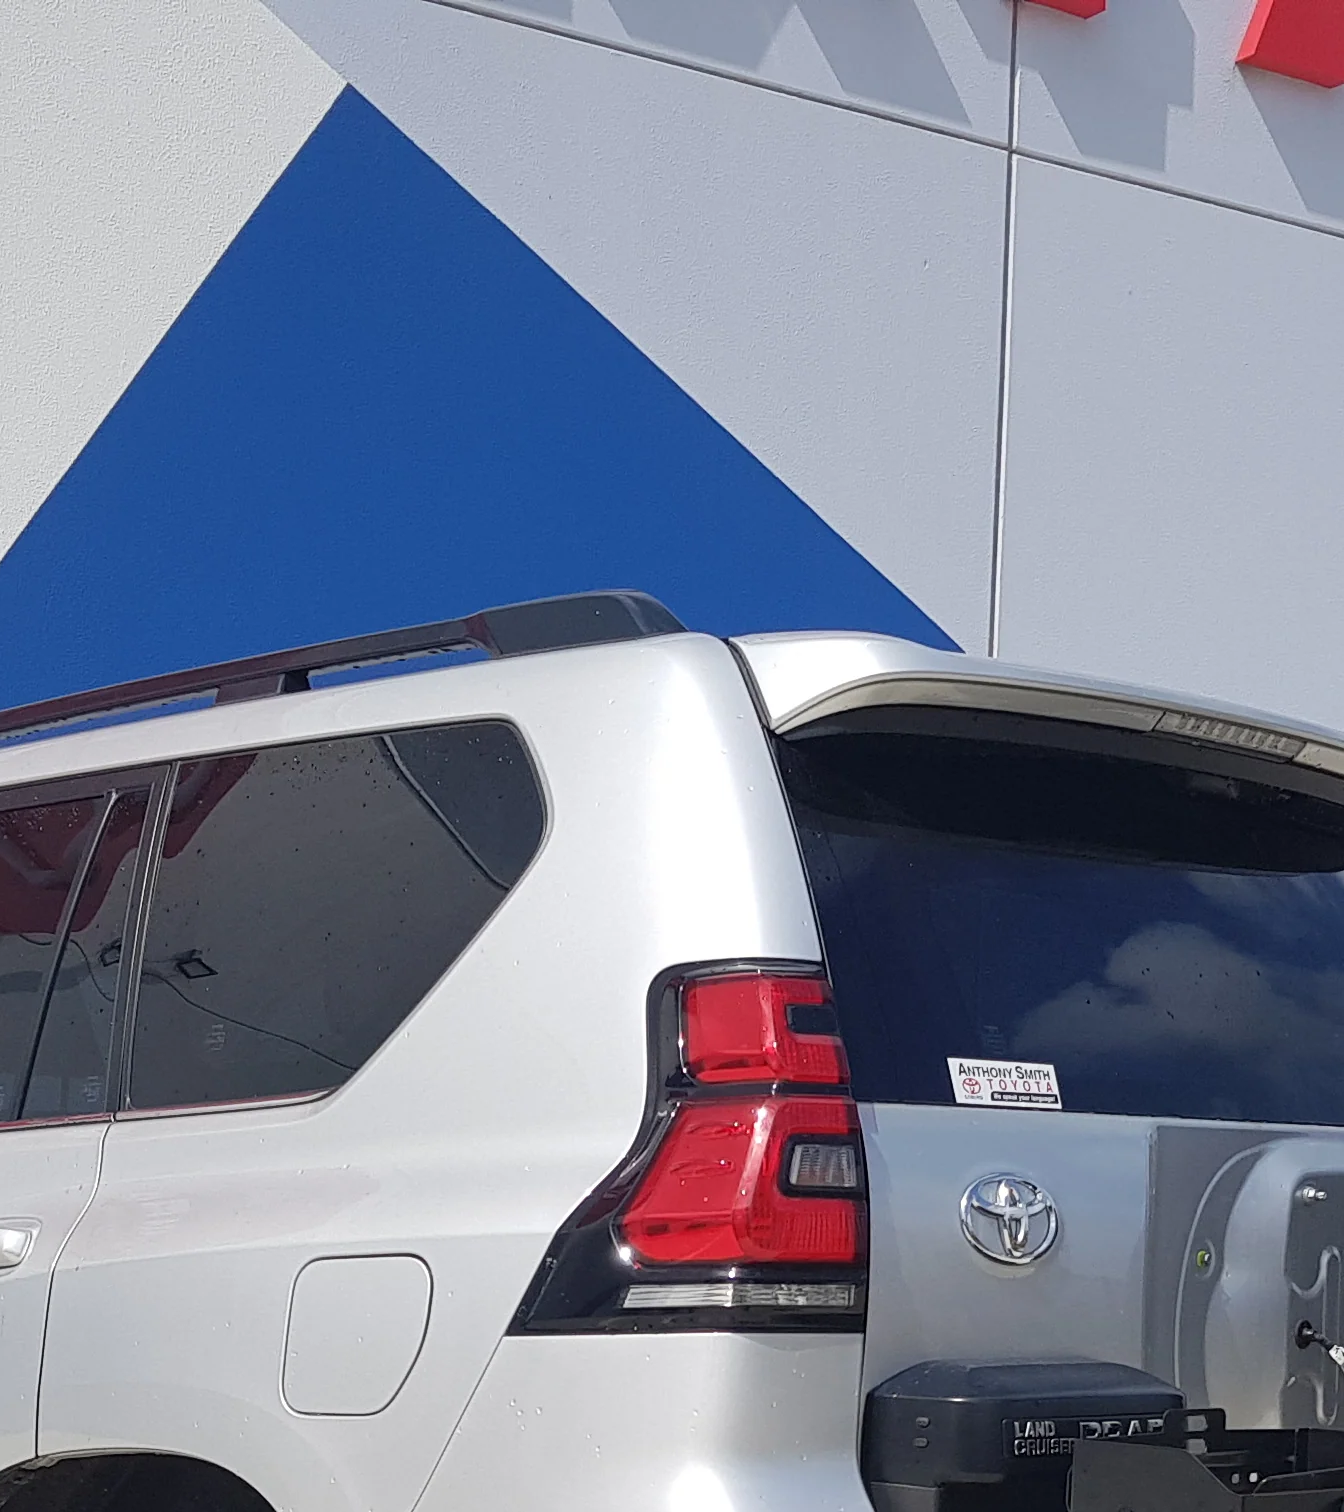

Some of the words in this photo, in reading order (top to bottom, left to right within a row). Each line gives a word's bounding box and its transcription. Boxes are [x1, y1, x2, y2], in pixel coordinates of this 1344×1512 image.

[959, 1063, 1012, 1079] ANTHONY
[1015, 1066, 1051, 1080] SMITH
[986, 1079, 1053, 1093] TOYOTA
[1014, 1420, 1056, 1438] LAND
